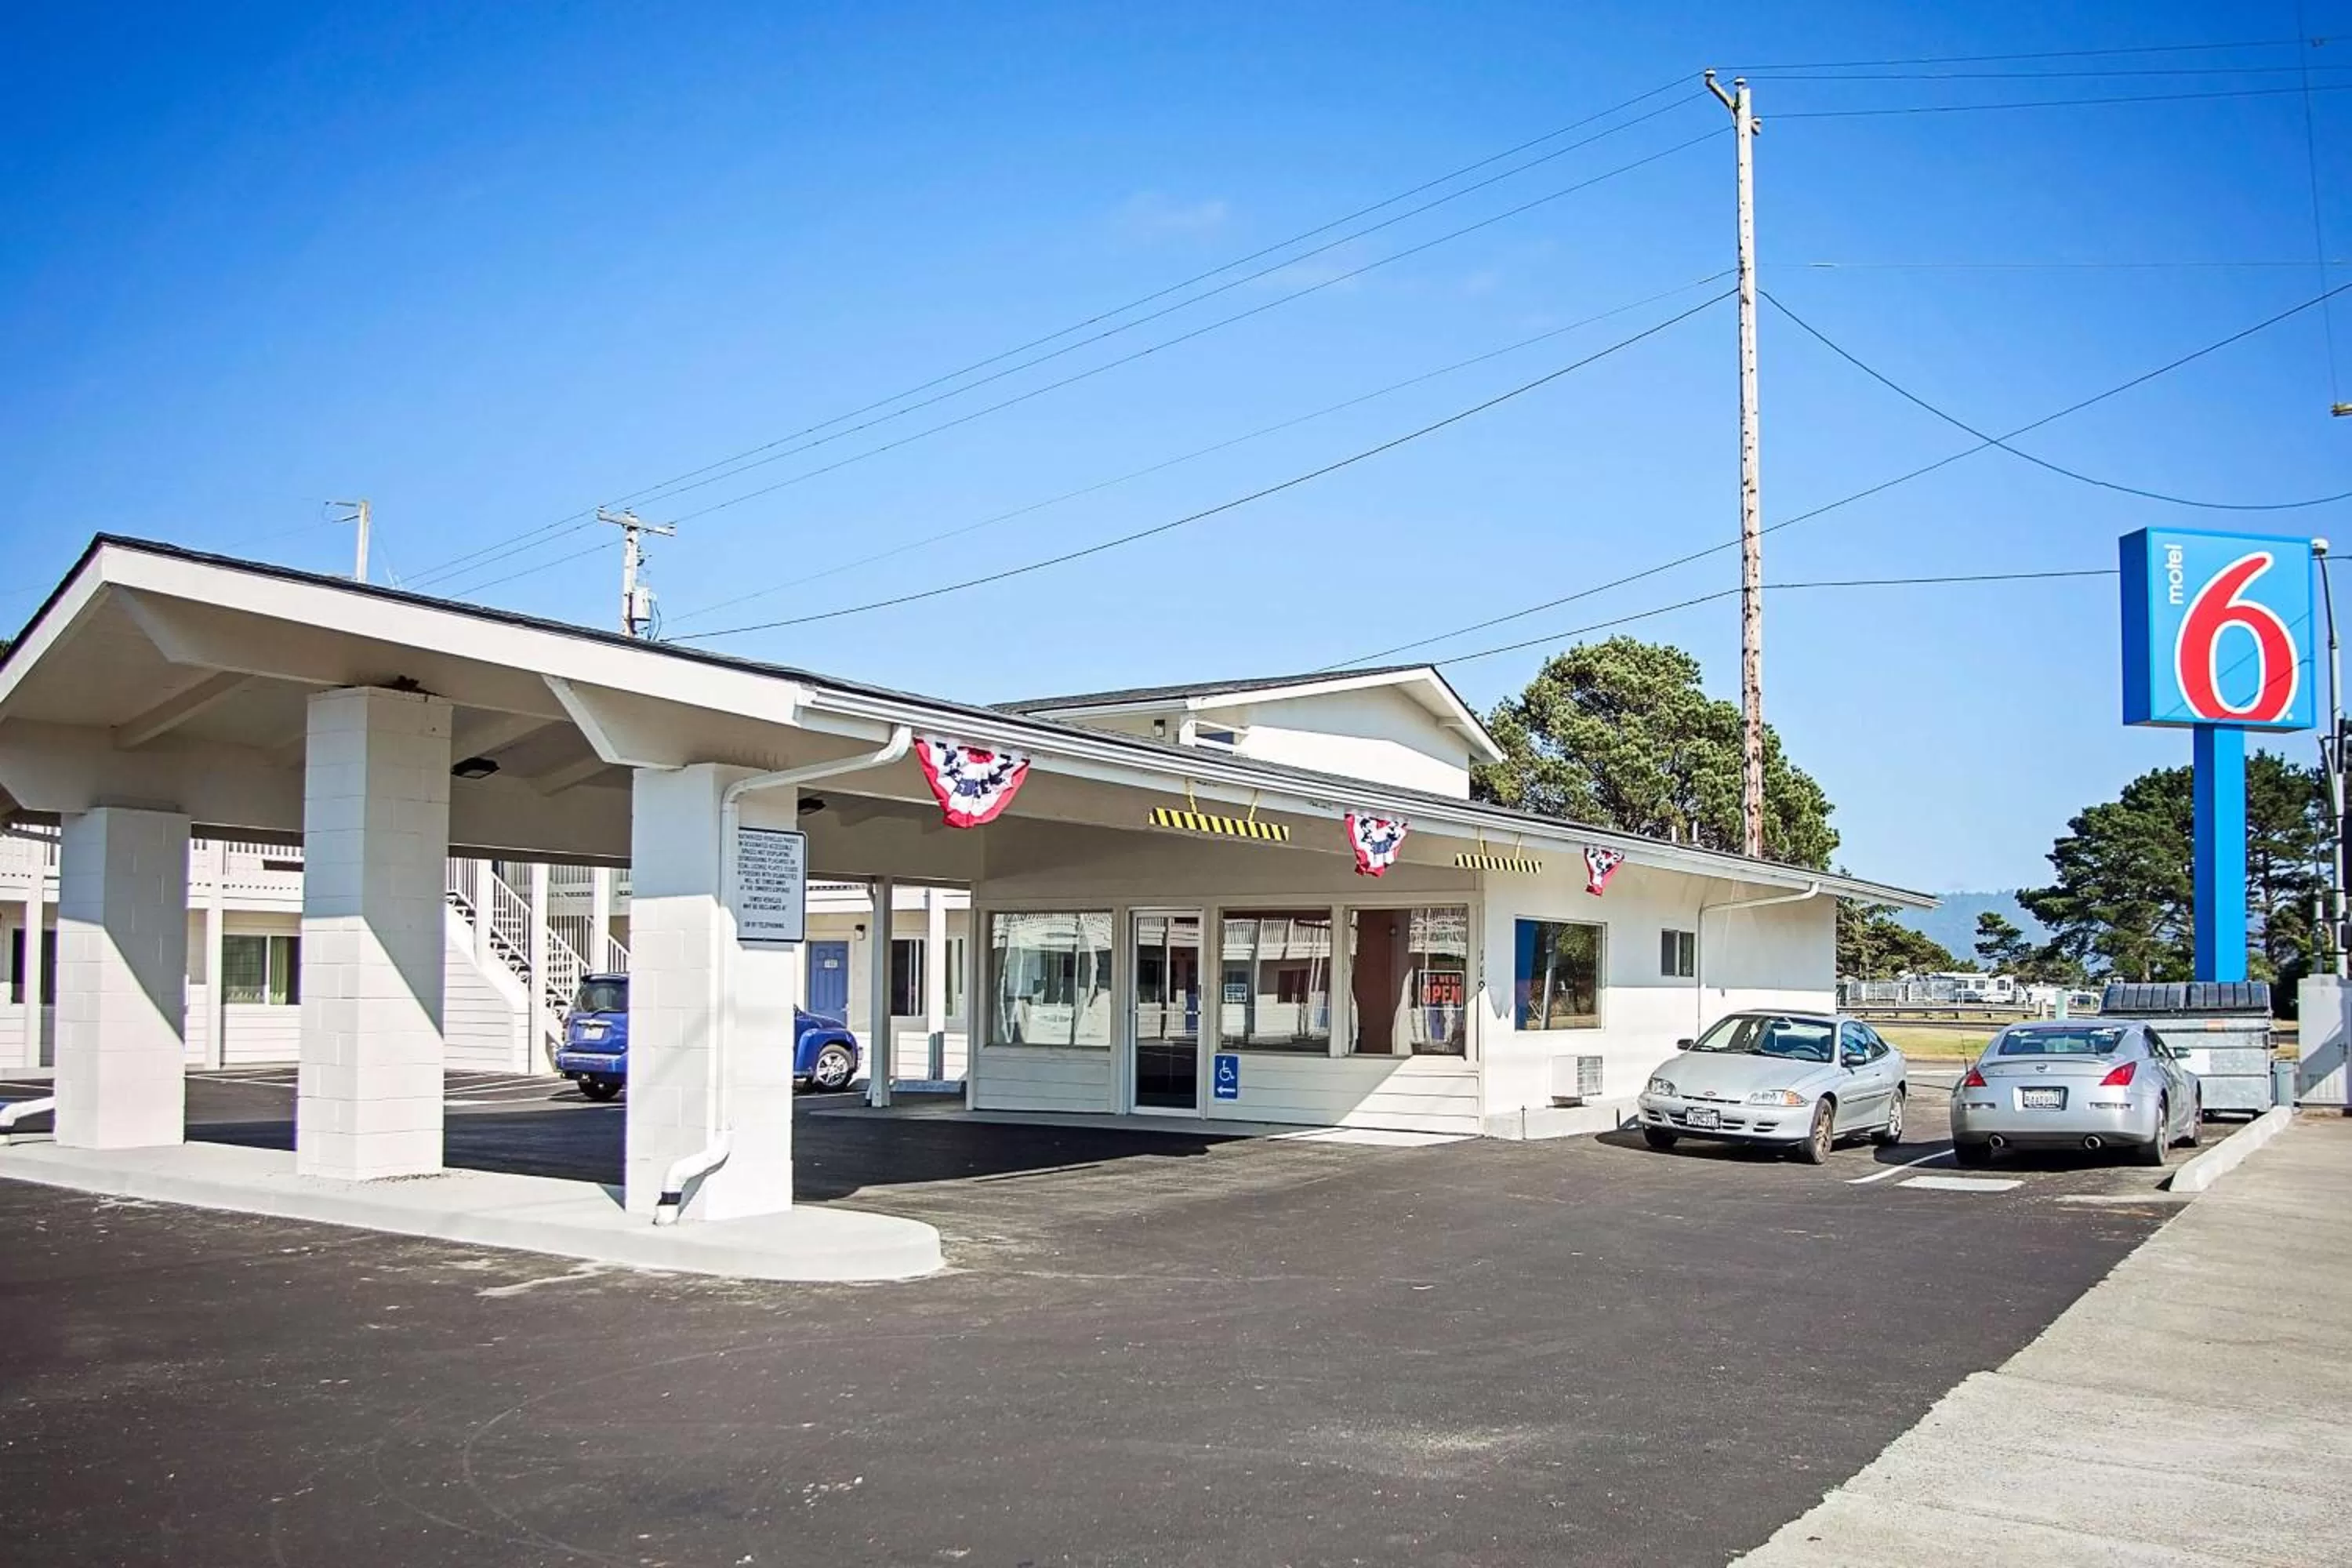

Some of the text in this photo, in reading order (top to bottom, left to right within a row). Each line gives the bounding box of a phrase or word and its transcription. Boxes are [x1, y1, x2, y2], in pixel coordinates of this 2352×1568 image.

[2164, 544, 2183, 604] motel
[2174, 551, 2299, 722] 6
[1422, 985, 1461, 1004] OPEN
